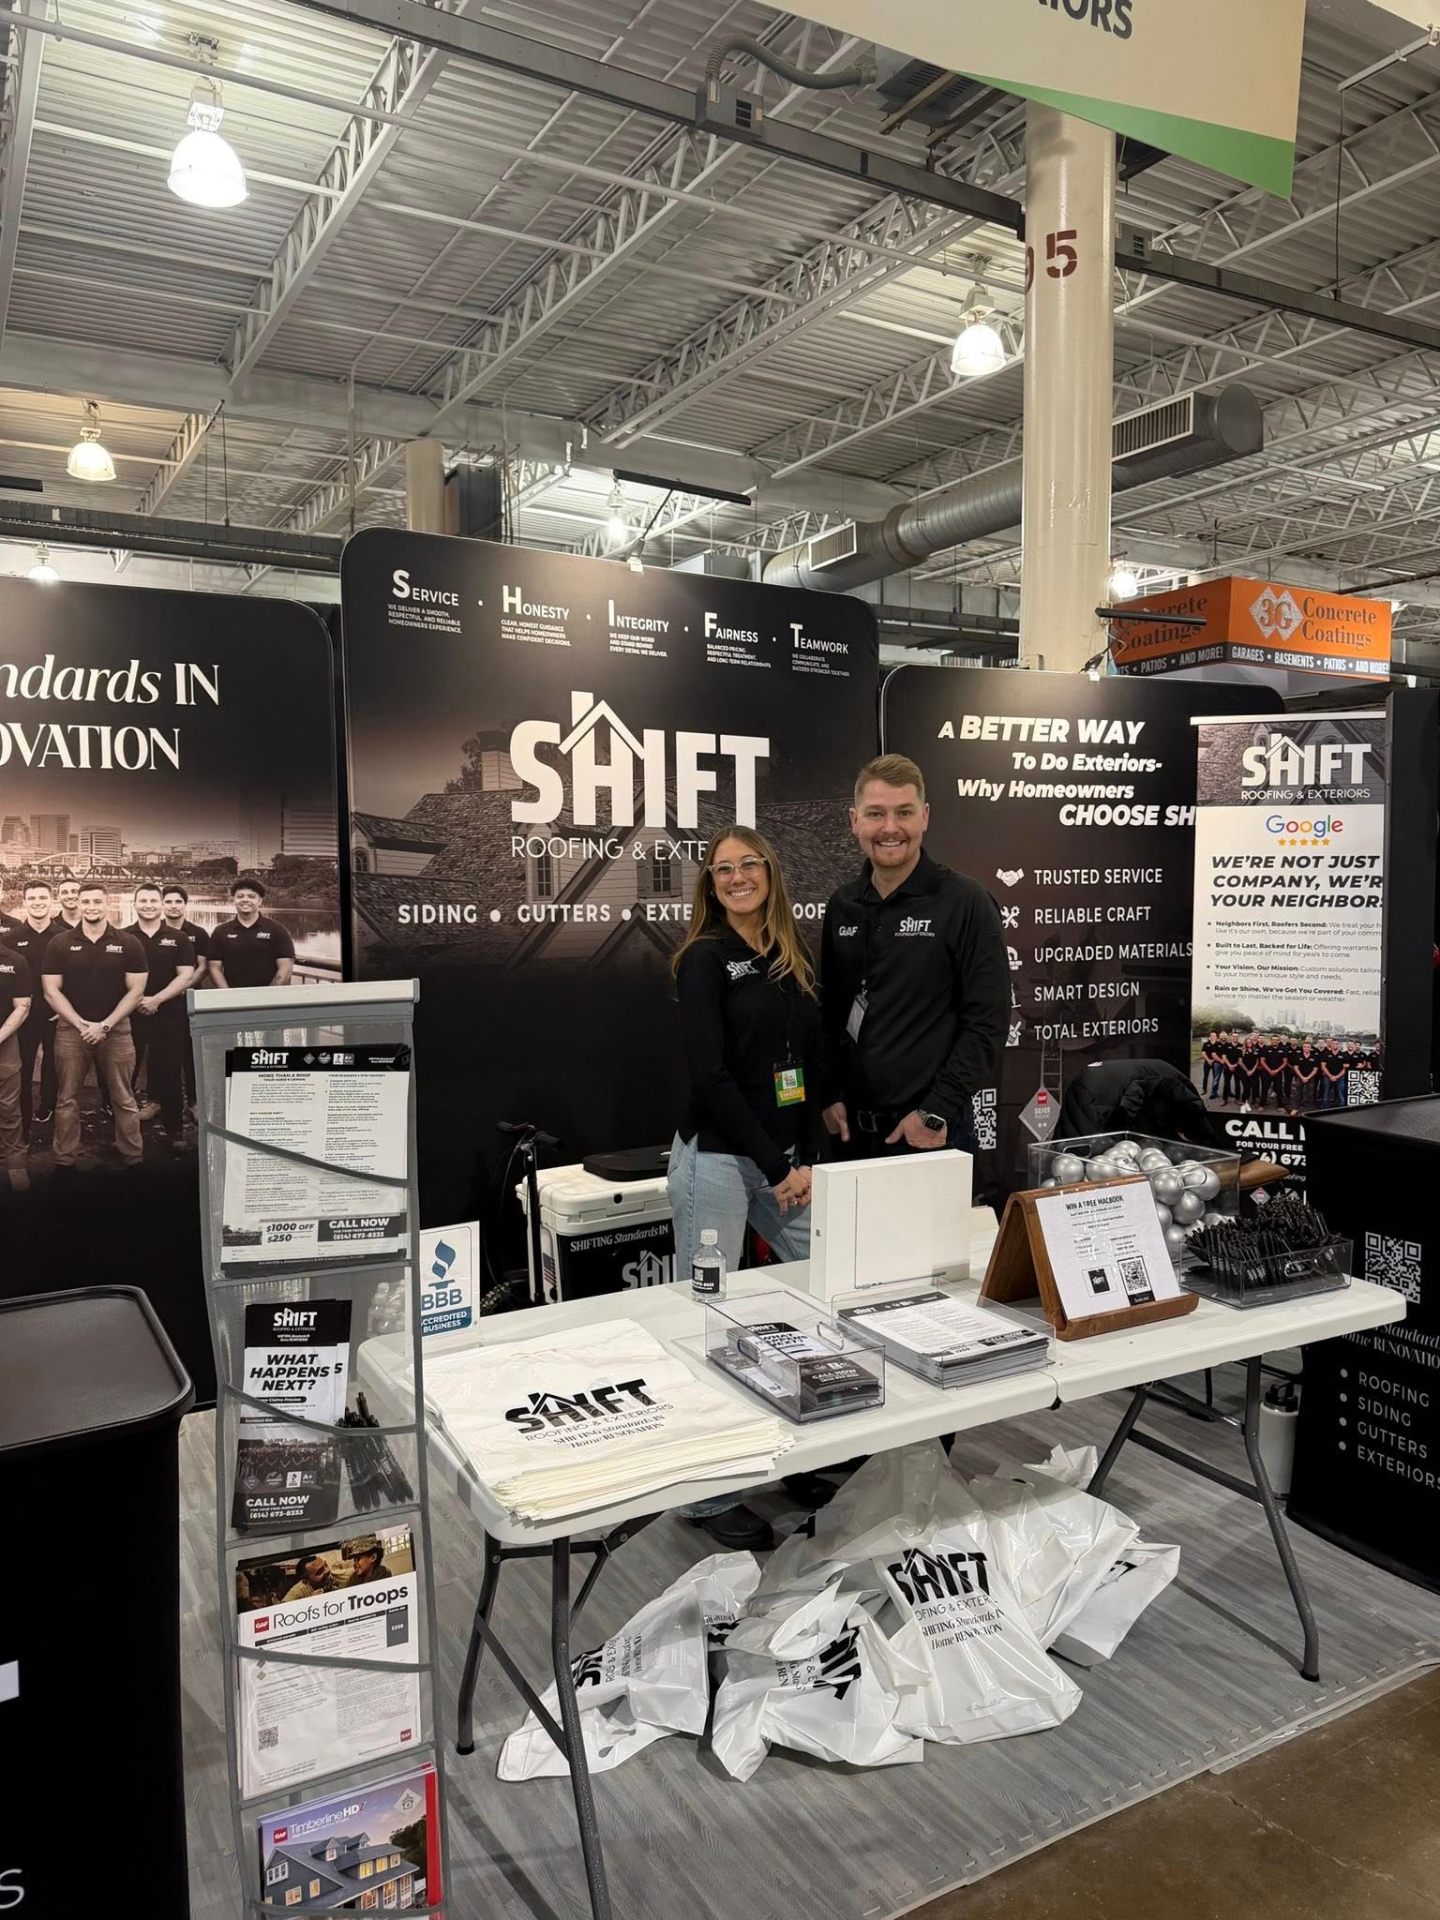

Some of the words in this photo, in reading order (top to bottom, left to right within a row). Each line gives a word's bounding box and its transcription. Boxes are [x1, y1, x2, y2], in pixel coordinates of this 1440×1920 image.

[392, 569, 459, 606] SERVICE
[503, 585, 570, 620] HONESTY
[1303, 596, 1378, 625] Concrete
[608, 599, 669, 633] INTEGRITY
[704, 612, 759, 643] FAIRNESS
[1302, 618, 1372, 651] Coatings
[790, 623, 849, 654] TEAMWORK
[1140, 657, 1168, 674] PATIOS
[1180, 650, 1197, 666] AND
[1198, 645, 1224, 661] MORE!
[1231, 645, 1265, 662] GARAGES
[1274, 651, 1314, 669] BASEMENTS
[1323, 657, 1347, 671] PATIOS
[1355, 660, 1370, 674] AND
[1370, 661, 1390, 675] MORE!
[174, 662, 219, 706] IN
[938, 721, 955, 739] A
[960, 715, 1070, 743] BETTER
[1077, 719, 1145, 745] WAY
[509, 690, 771, 830] SHIFT
[1012, 752, 1037, 771] To
[1040, 753, 1068, 771] Do
[1242, 733, 1372, 786] SHIFT
[958, 779, 1005, 802] Why
[1008, 780, 1134, 799] Homeowners
[1241, 789, 1293, 800] ROOFING
[1296, 790, 1305, 799] &
[1307, 788, 1371, 800] EXTERIORS
[1059, 804, 1160, 826] CHOOSE
[1266, 814, 1344, 838] Google
[511, 836, 625, 861] ROOFING
[631, 841, 647, 861] &
[1280, 855, 1324, 868] NOT
[1328, 855, 1380, 869] JUST
[1034, 869, 1100, 885] TRUSTED
[1104, 868, 1163, 884] SERVICE
[1213, 875, 1321, 891] COMPANY,
[1210, 894, 1265, 907] YOUR
[398, 904, 478, 925] SIDING
[517, 903, 611, 923] GUTTERS
[899, 916, 932, 933] SHIFT
[1034, 908, 1102, 924] RELIABLE
[1107, 906, 1151, 922] CRAFT
[1216, 920, 1251, 928] Neighbors
[839, 926, 859, 937] GAF
[1034, 945, 1114, 963] UPGRADED
[1118, 942, 1193, 959] MATERIALS
[1313, 943, 1341, 951] Offering
[1034, 984, 1084, 1001] SMART
[1088, 982, 1140, 999] DESIGN
[1034, 1023, 1078, 1041] TOTAL
[1082, 1018, 1159, 1037] EXTERIORS
[251, 1048, 289, 1065] SHIFT
[1225, 1119, 1294, 1140] CALL
[1236, 1140, 1254, 1148] FOR
[1255, 1141, 1280, 1150] YOUR
[1281, 1142, 1304, 1151] FREE
[266, 1223, 297, 1233] $1000
[298, 1223, 315, 1231] OFF
[329, 1220, 359, 1229] CALL
[360, 1218, 390, 1227] NOW
[267, 1234, 292, 1243] $250
[570, 1235, 613, 1253] SHIFTING
[613, 1226, 659, 1244] Standards
[659, 1223, 669, 1235] IN
[421, 1288, 463, 1311] BBB
[273, 1307, 318, 1327] SHIFT
[421, 1310, 467, 1326] CCREDITED
[423, 1319, 462, 1333] BUSINESS
[267, 1353, 319, 1366] WHAT
[250, 1366, 330, 1379] HAPPENS
[262, 1379, 317, 1391] NEXT?
[1358, 1371, 1430, 1408] ROOFING
[505, 1378, 658, 1434] SHIFT
[1358, 1396, 1411, 1427] SIDING
[525, 1423, 588, 1442] ROOFING
[604, 1403, 675, 1424] EXTERIORS
[1357, 1421, 1428, 1459] GUTTERS
[246, 1497, 277, 1507] CALL
[279, 1495, 310, 1506] NOW
[249, 1511, 269, 1519] (614)
[255, 1620, 270, 1630] GAF
[273, 1605, 320, 1630] Roofs
[323, 1600, 345, 1616] for
[348, 1585, 408, 1612] Troops
[931, 1635, 956, 1650] Home
[274, 1831, 287, 1840] GAF
